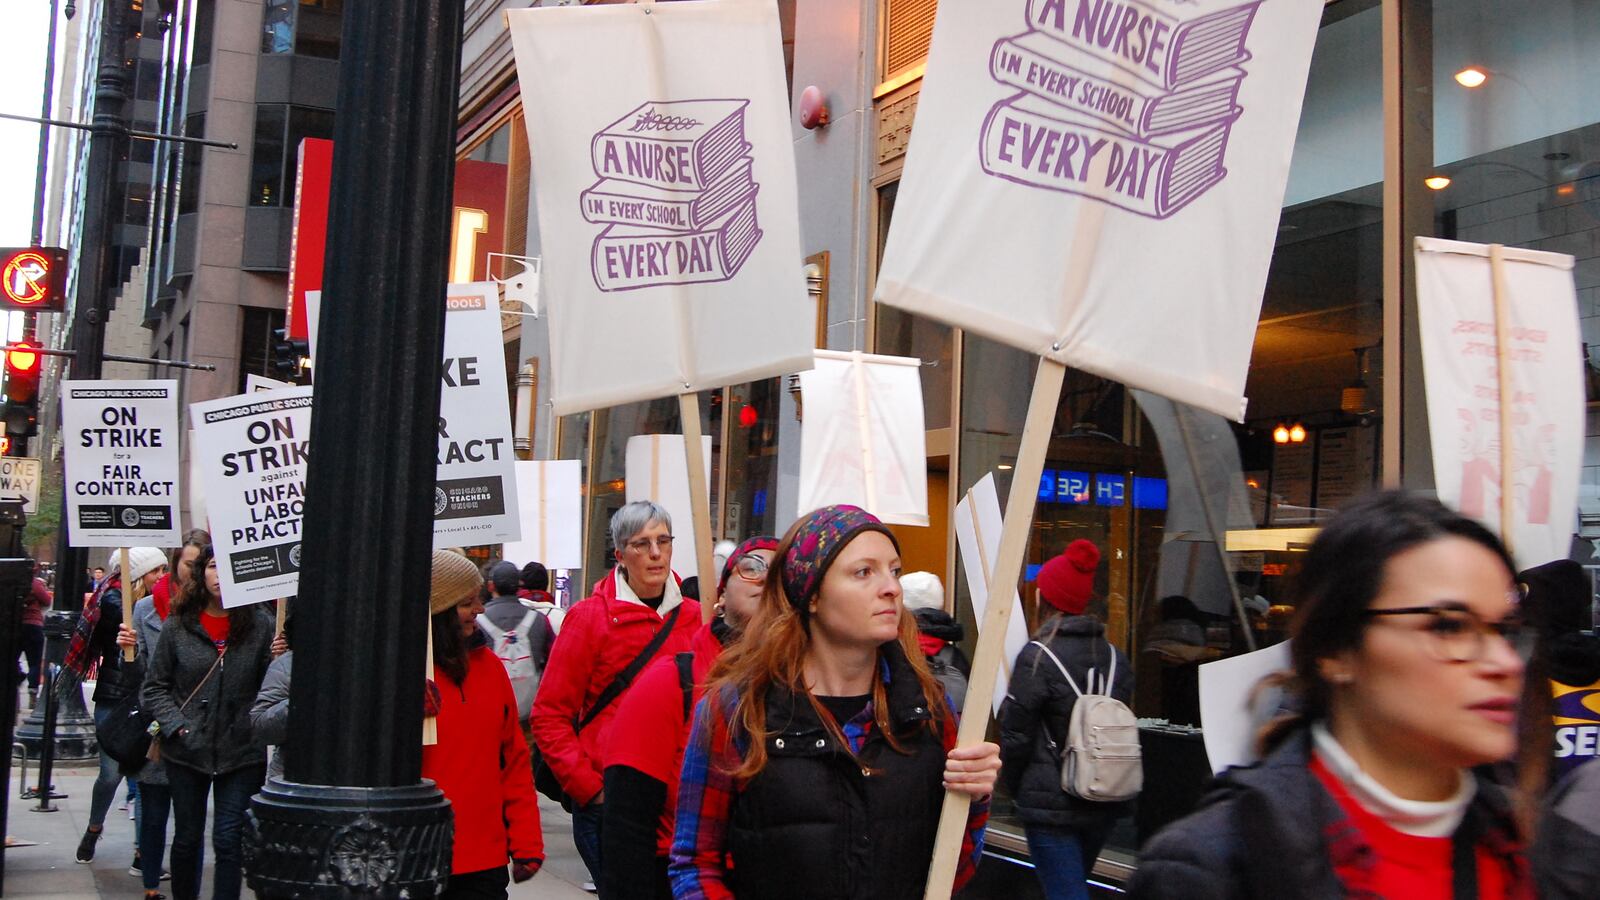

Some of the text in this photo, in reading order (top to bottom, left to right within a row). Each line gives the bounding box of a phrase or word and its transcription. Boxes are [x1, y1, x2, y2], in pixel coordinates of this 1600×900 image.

[1038, 0, 1170, 76] A NURSE
[1000, 51, 1135, 126] IN EVERY SCHOOL
[603, 140, 693, 184] A NURSE
[998, 117, 1162, 200] EVERY DAY
[588, 199, 686, 226] IN EVERY SCHOOL
[605, 235, 715, 279] EVERY DAY
[102, 407, 137, 426] ON
[206, 407, 250, 421] CHICAGO
[250, 401, 284, 413] PUBLIC
[81, 429, 162, 447] STRIKE
[247, 416, 294, 444] ON
[3, 462, 34, 476] ONE
[103, 465, 141, 479] FAIR
[261, 469, 298, 482] against
[0, 477, 34, 491] WAY
[75, 481, 173, 496] CONTRACT
[450, 494, 491, 502] TEACHERS
[232, 519, 300, 545] PRACT
